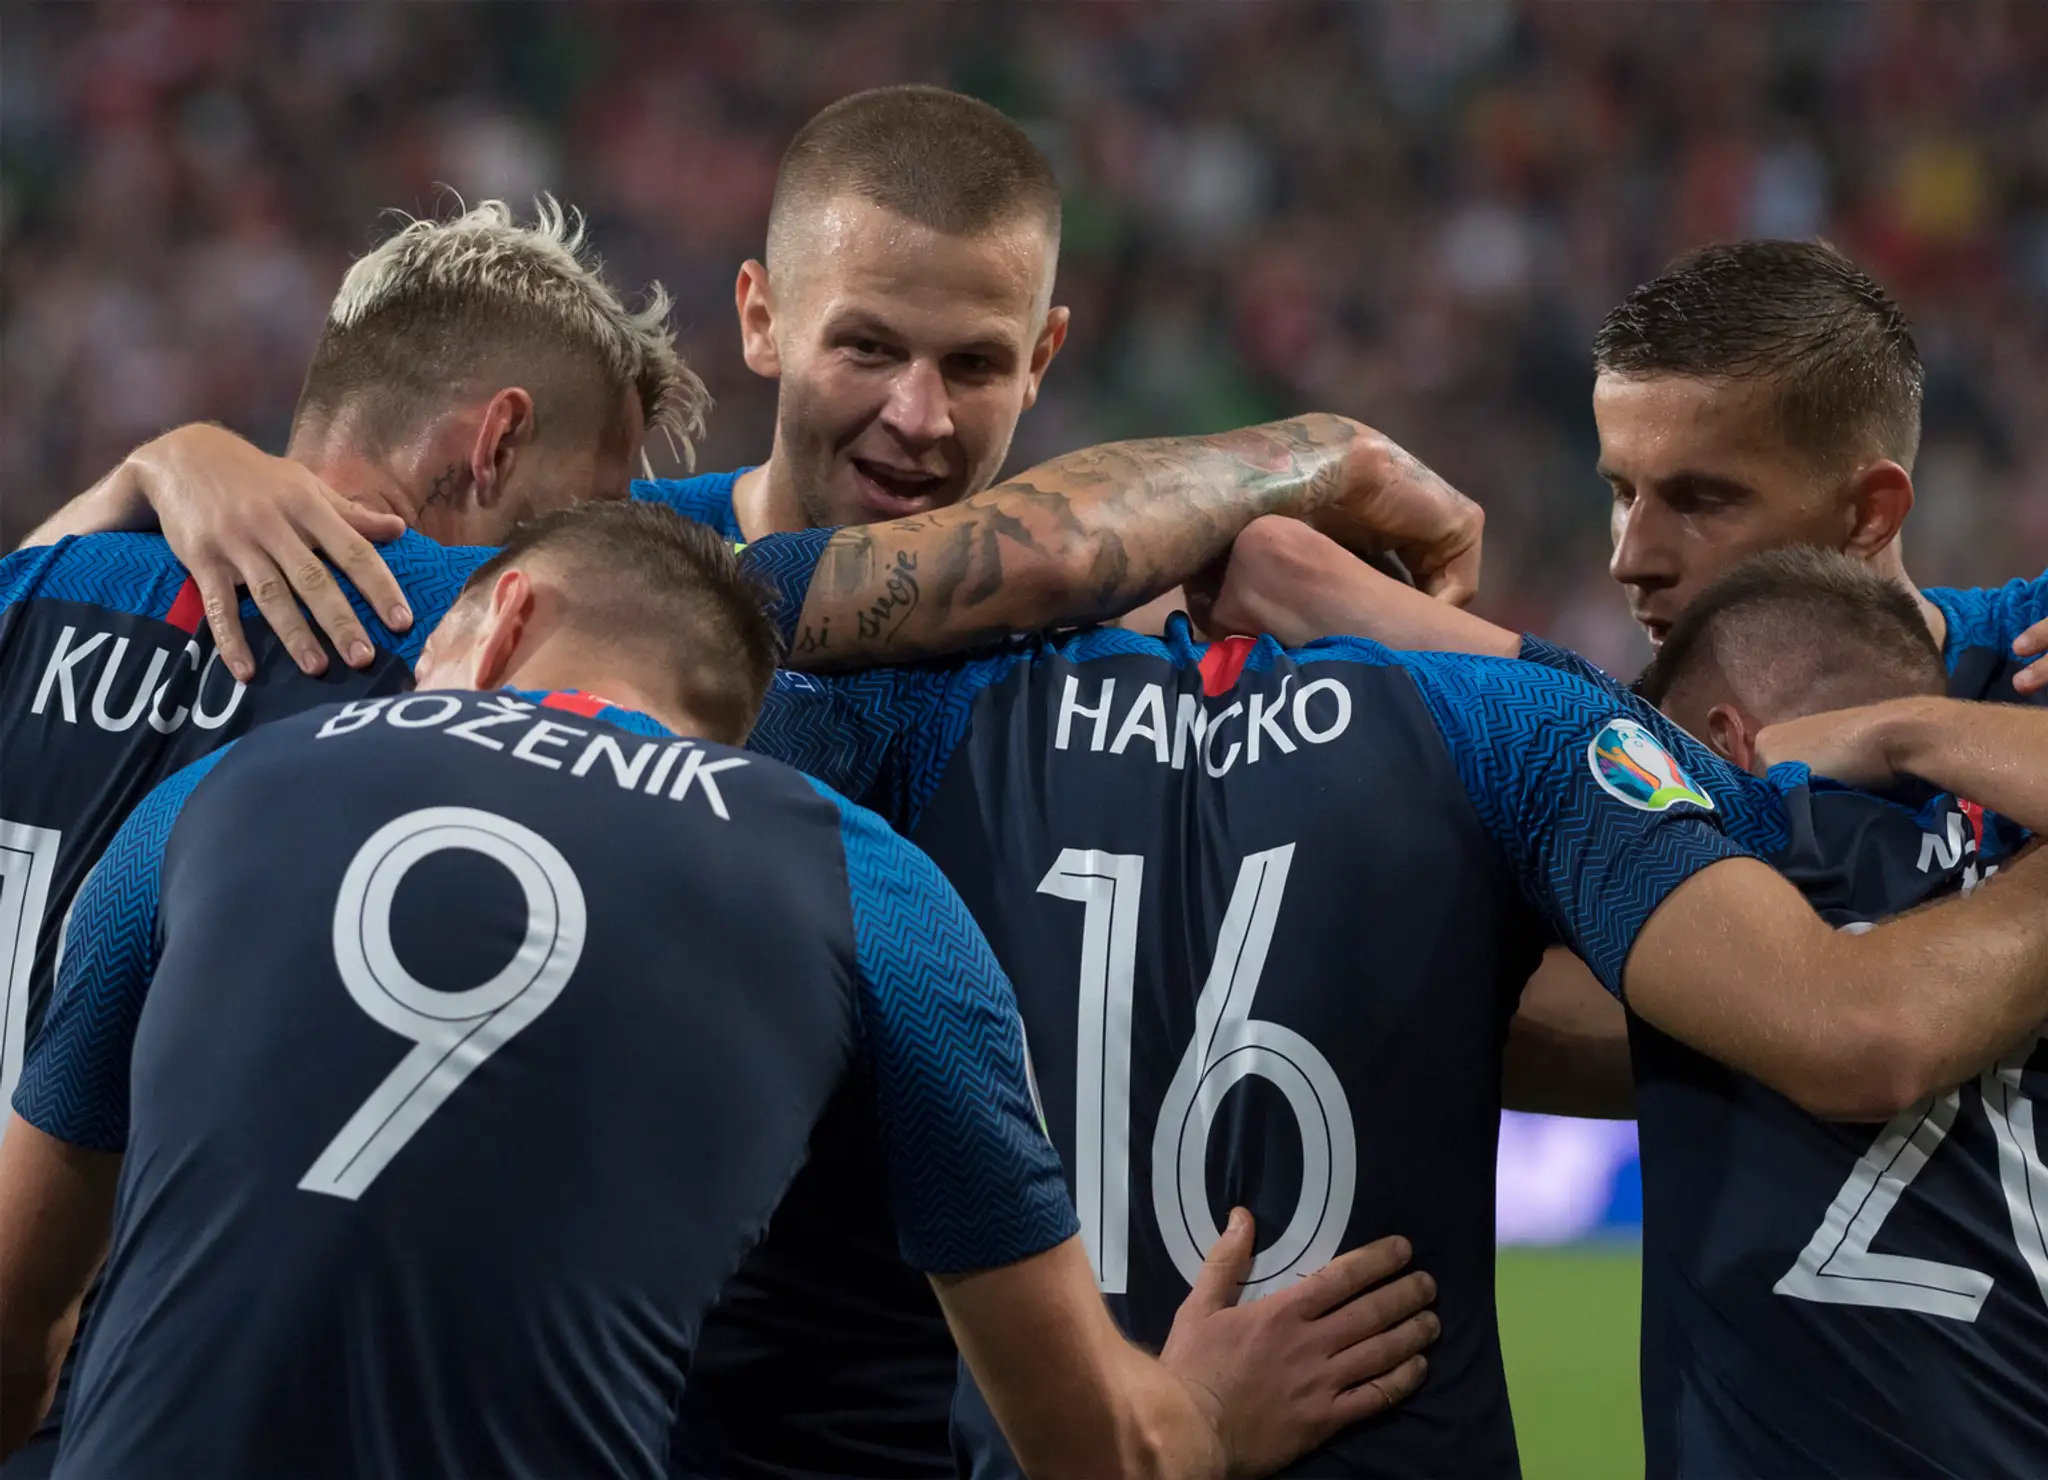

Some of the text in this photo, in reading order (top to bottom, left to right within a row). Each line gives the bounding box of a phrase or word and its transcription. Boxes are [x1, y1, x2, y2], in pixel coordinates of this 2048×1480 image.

[315, 695, 751, 821] BOŽENÍK
[1054, 674, 1352, 778] HANCKO
[297, 805, 588, 1201] 9
[1035, 841, 1357, 1304] 16
